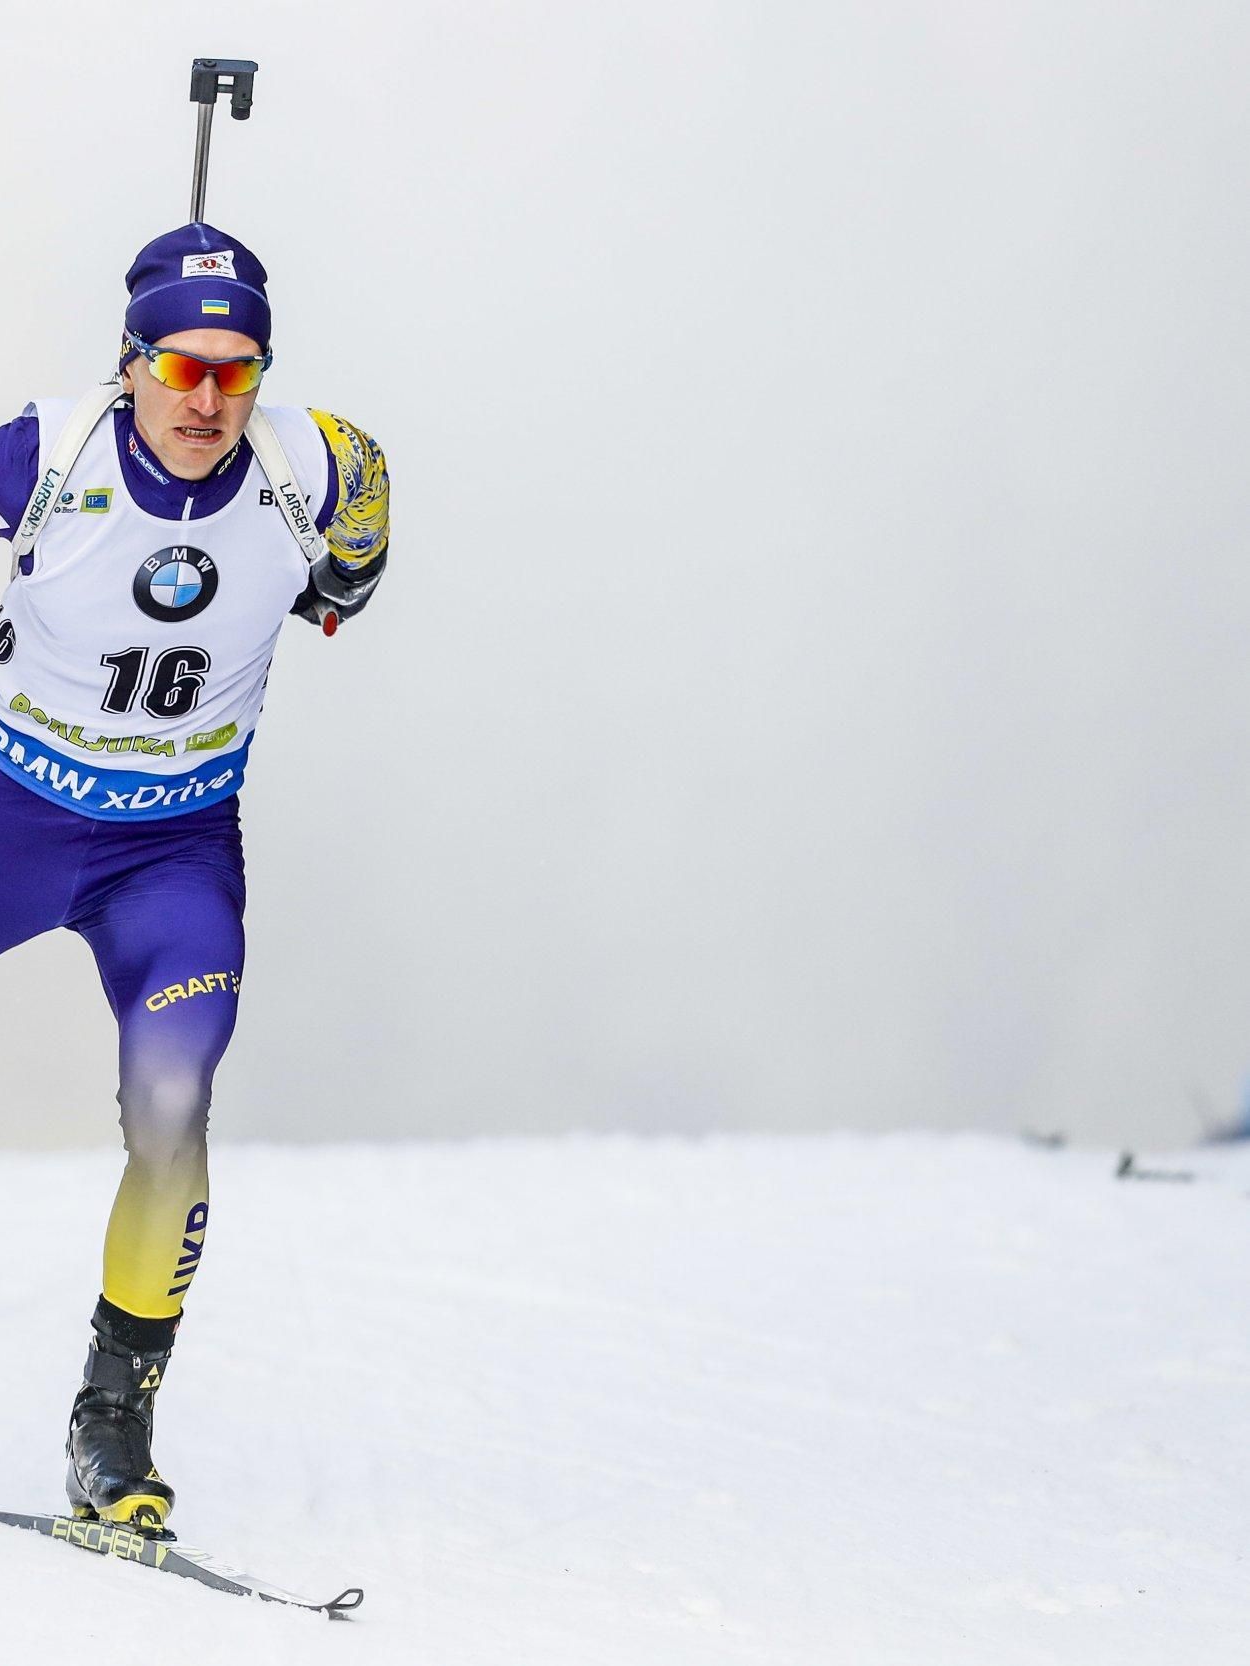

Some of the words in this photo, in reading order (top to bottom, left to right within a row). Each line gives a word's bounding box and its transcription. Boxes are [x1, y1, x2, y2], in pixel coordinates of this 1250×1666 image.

[135, 450, 167, 484] LAPUA
[27, 468, 60, 528] LARSEN
[279, 483, 311, 534] LARSEN
[143, 548, 214, 573] BMW
[100, 646, 211, 719] 16
[100, 768, 234, 810] xDrive
[145, 973, 227, 1012] CRAFT
[52, 1519, 145, 1561] FISCHER
